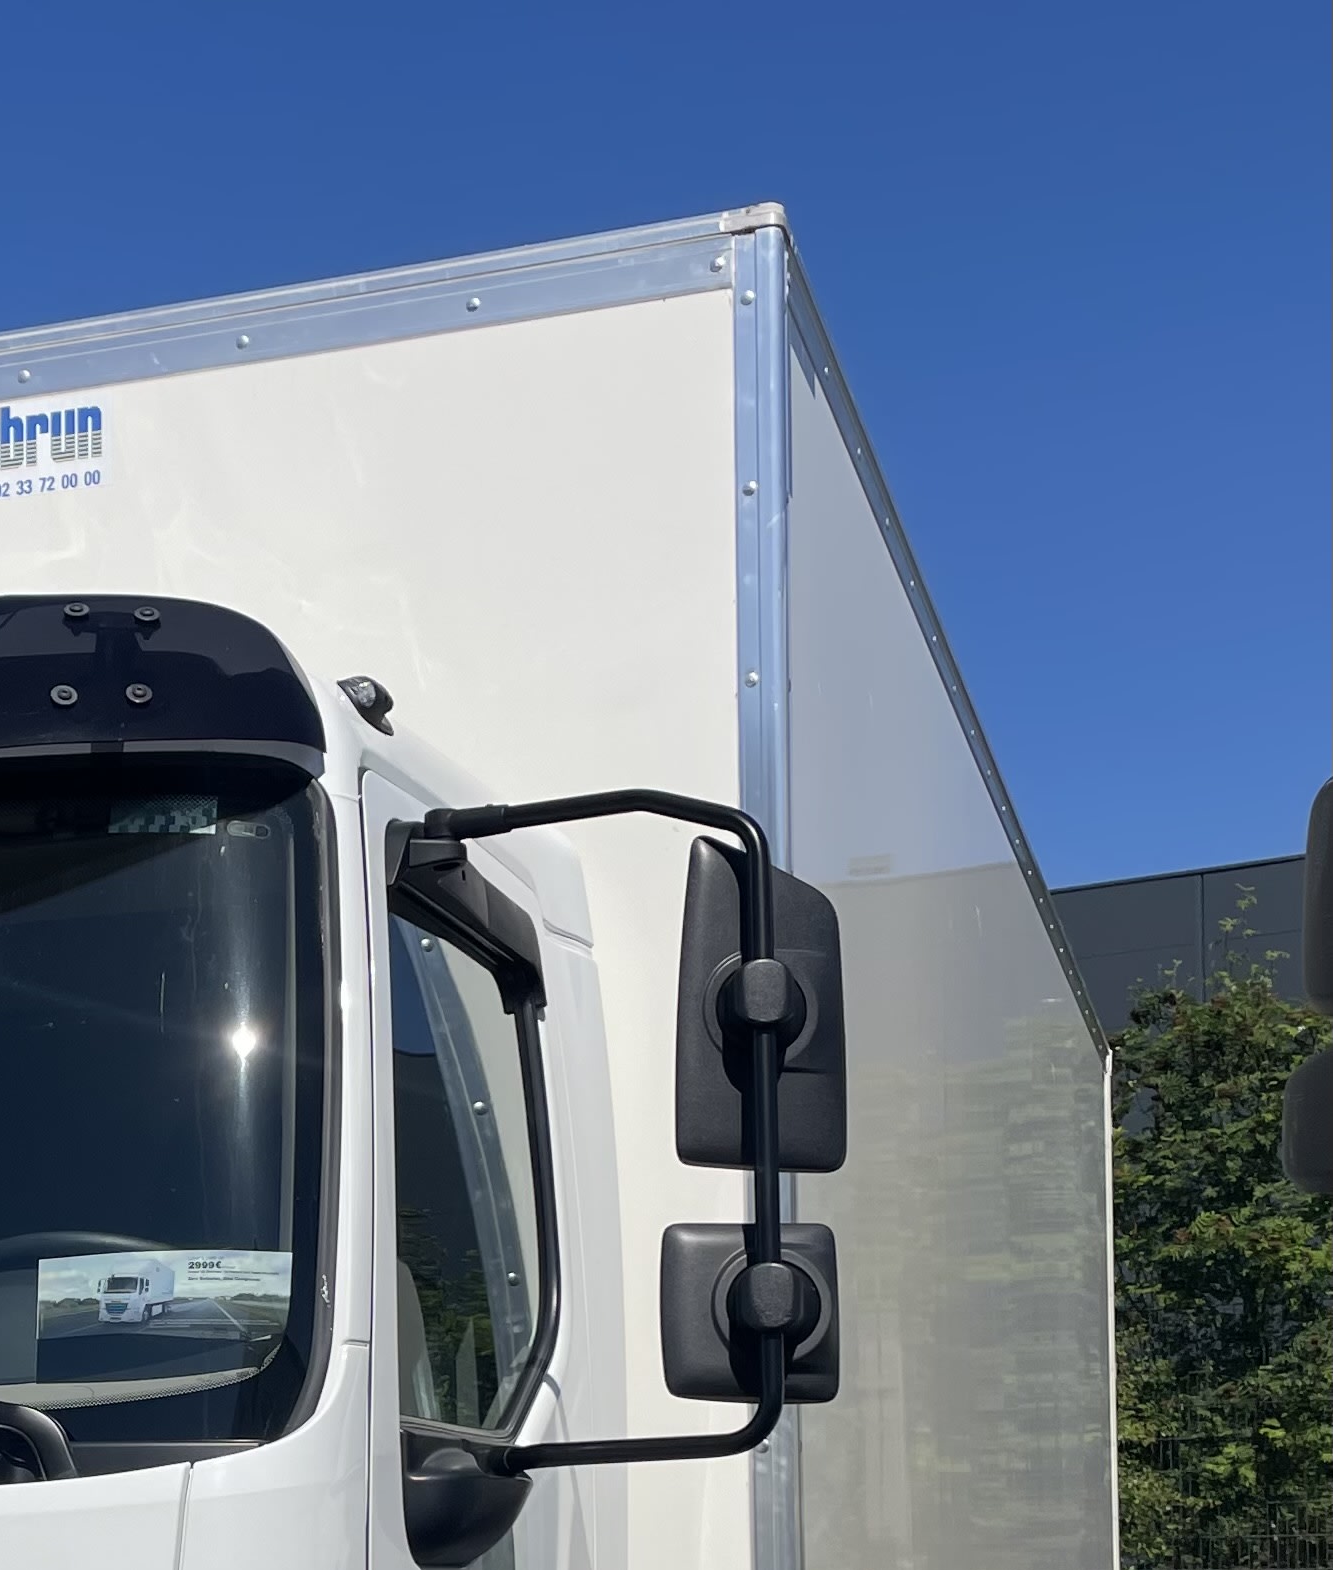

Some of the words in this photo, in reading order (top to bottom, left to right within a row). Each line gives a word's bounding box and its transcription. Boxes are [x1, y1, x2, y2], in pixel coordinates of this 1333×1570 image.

[16, 479, 32, 495] 33
[39, 476, 55, 492] 72
[62, 473, 78, 489] 00
[84, 470, 101, 486] 00
